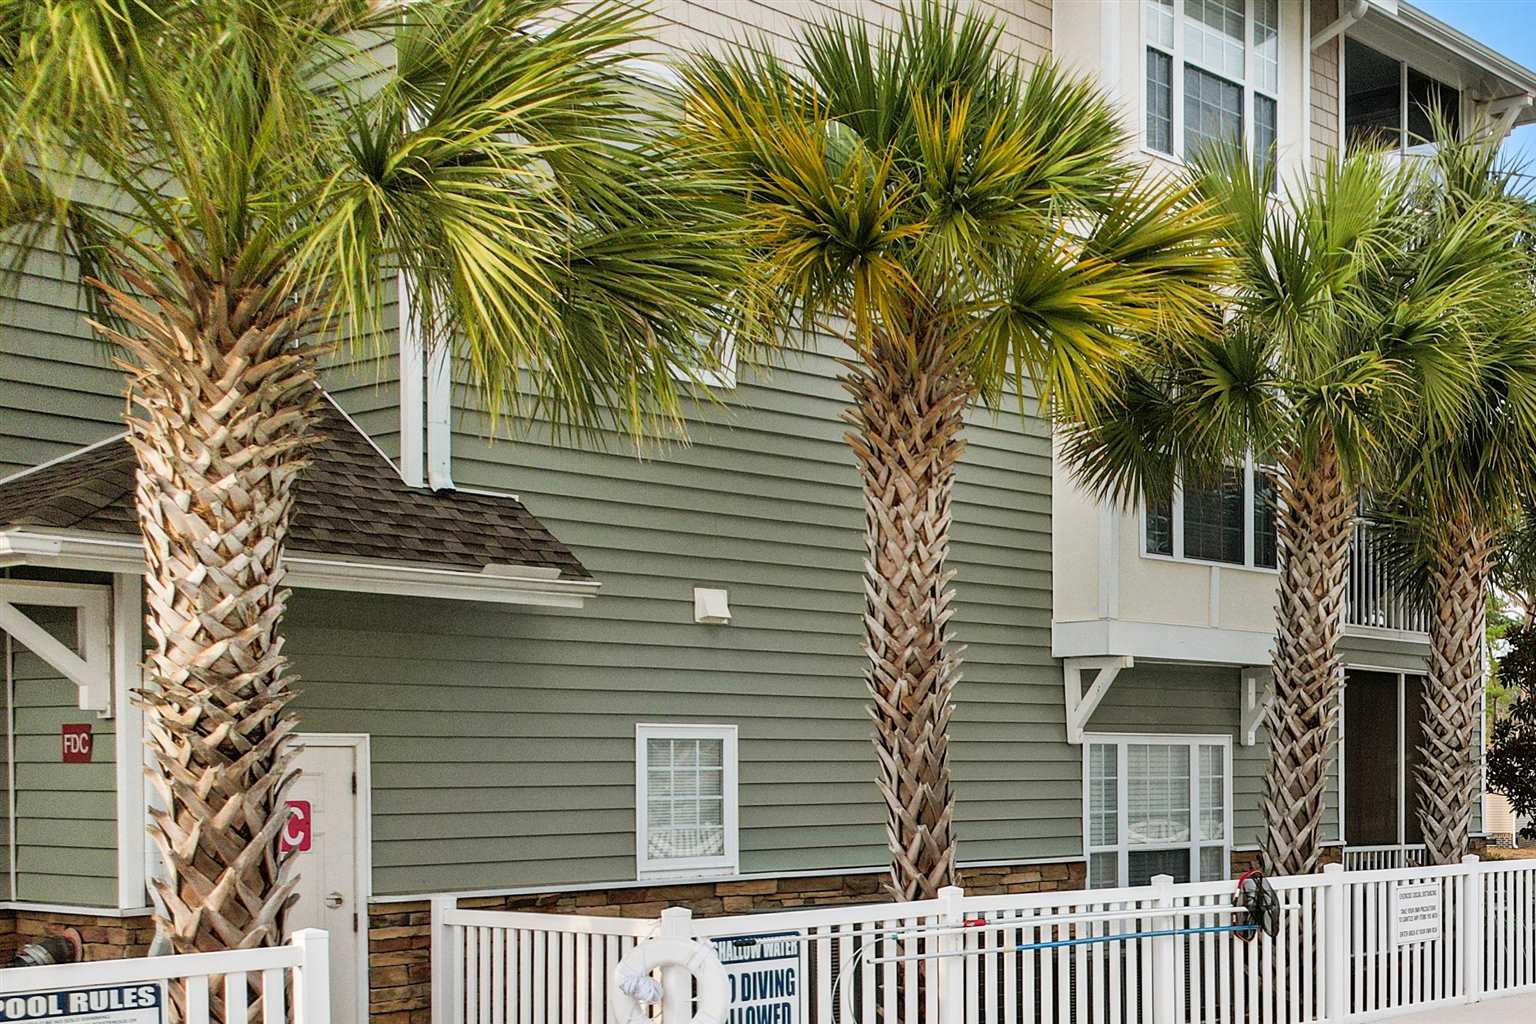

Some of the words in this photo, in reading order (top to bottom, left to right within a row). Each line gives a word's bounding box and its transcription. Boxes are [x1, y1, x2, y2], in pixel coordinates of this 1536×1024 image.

[64, 733, 89, 754] FDC
[284, 806, 304, 846] C
[761, 936, 798, 958] WATER
[741, 967, 796, 1002] DIVING
[0, 995, 63, 1019] OOL
[70, 986, 157, 1012] RULES
